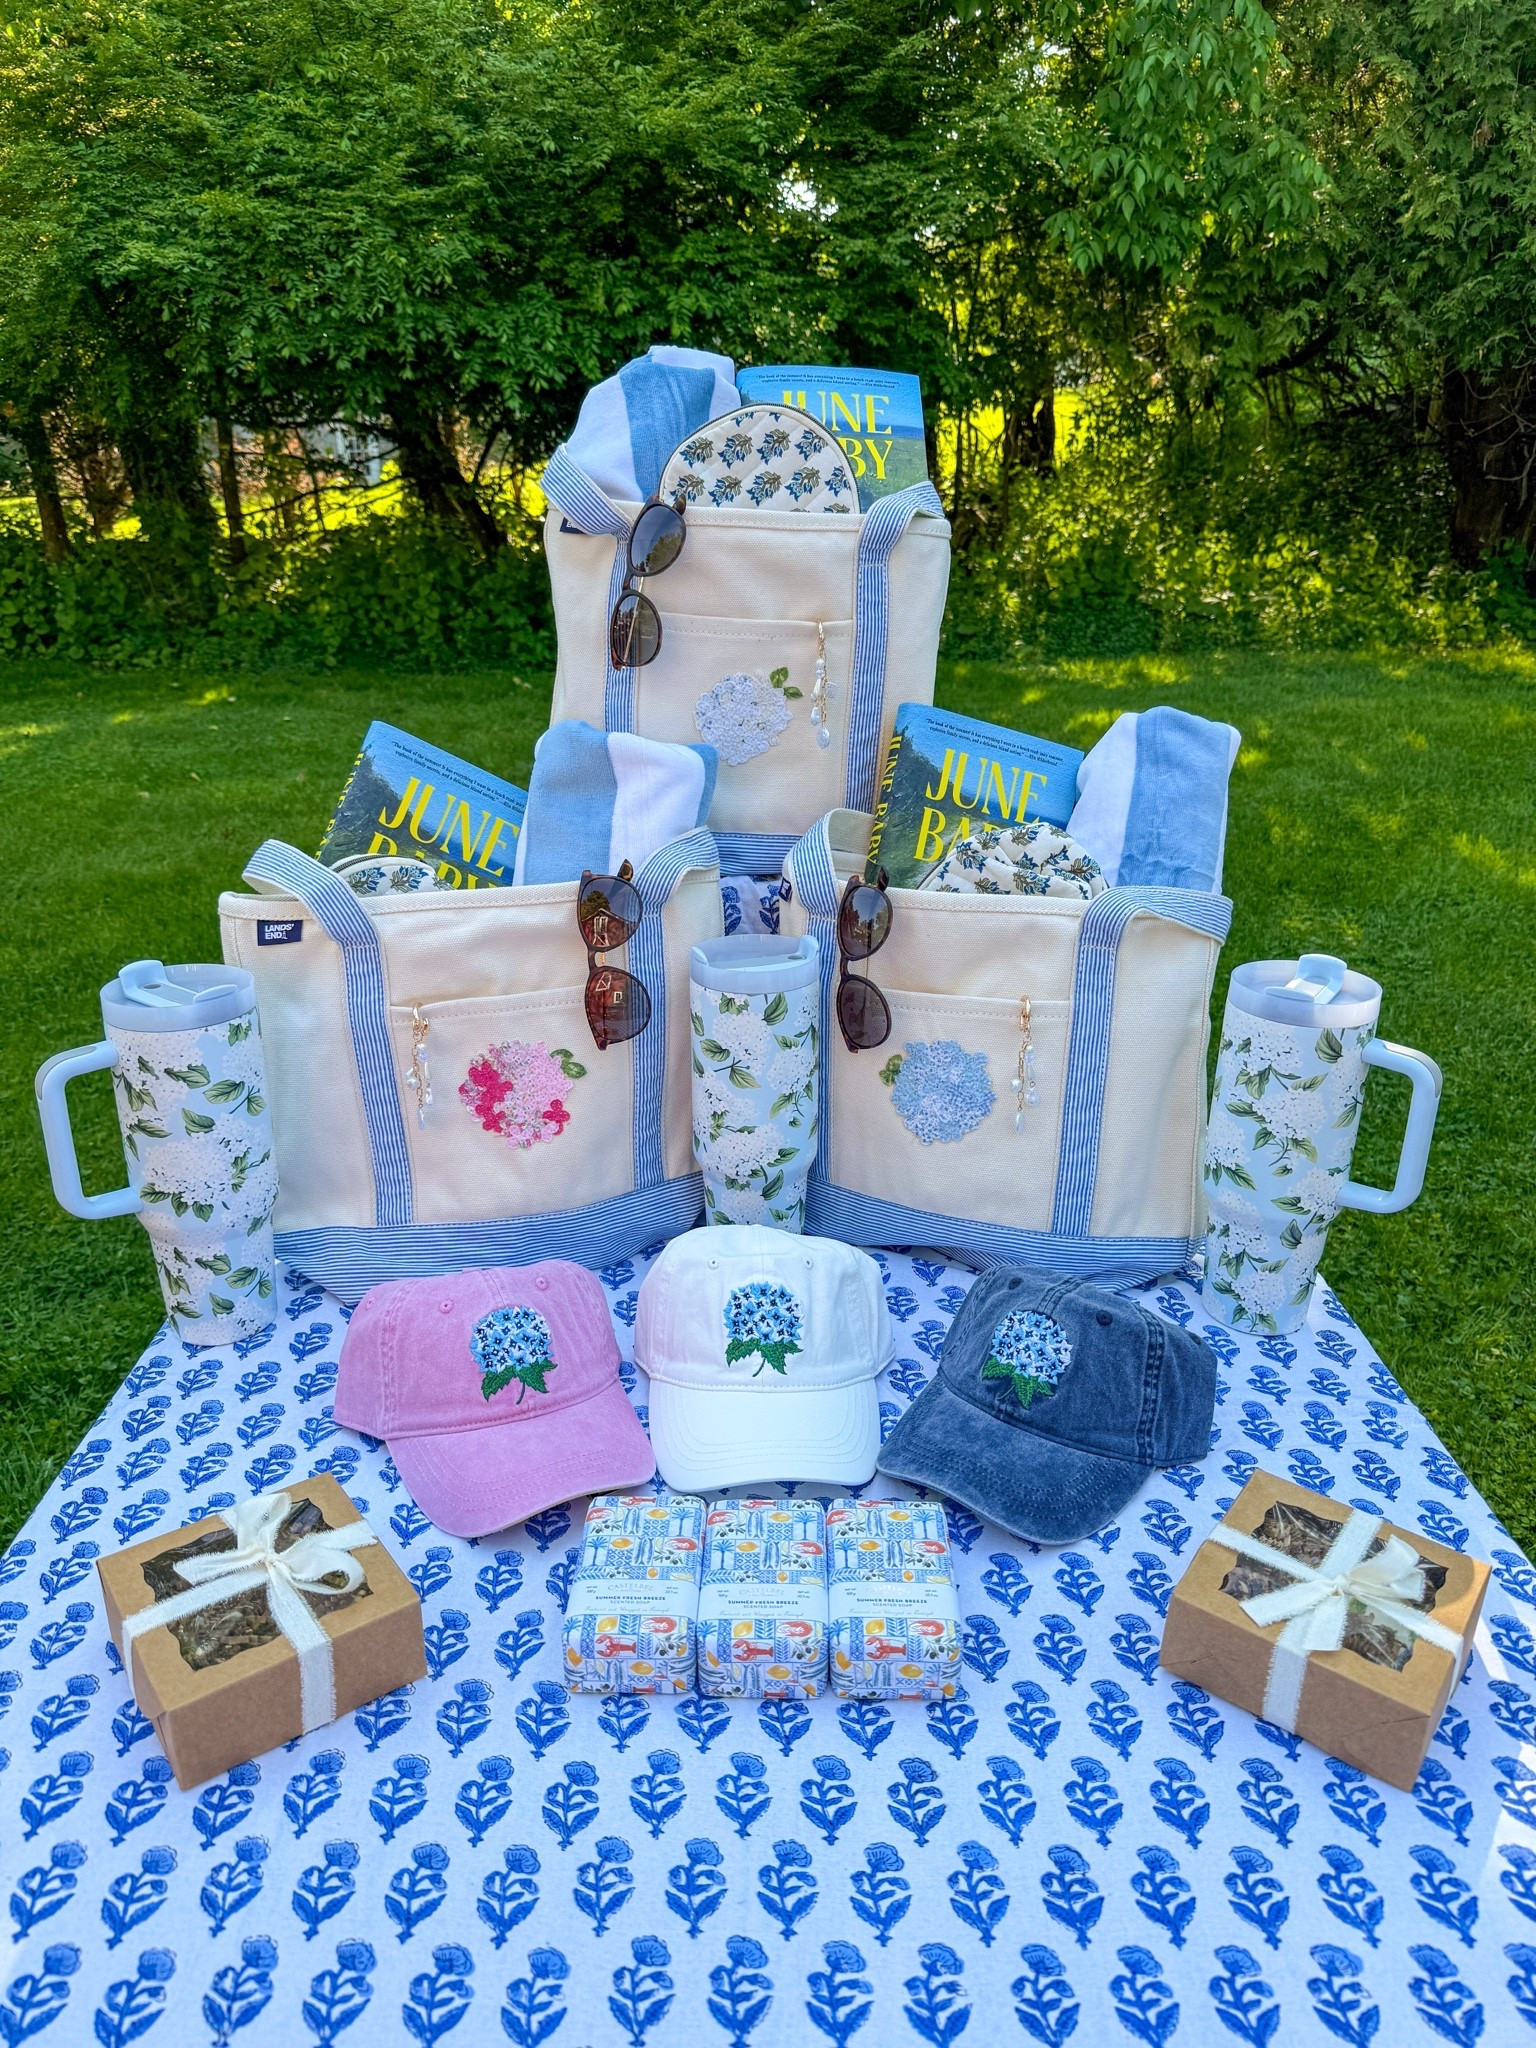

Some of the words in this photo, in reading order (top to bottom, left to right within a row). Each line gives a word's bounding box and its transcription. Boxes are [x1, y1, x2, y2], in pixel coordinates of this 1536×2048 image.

[925, 748, 1048, 826] JUNE
[378, 776, 521, 877] JUNE
[265, 923, 295, 932] LANDS'
